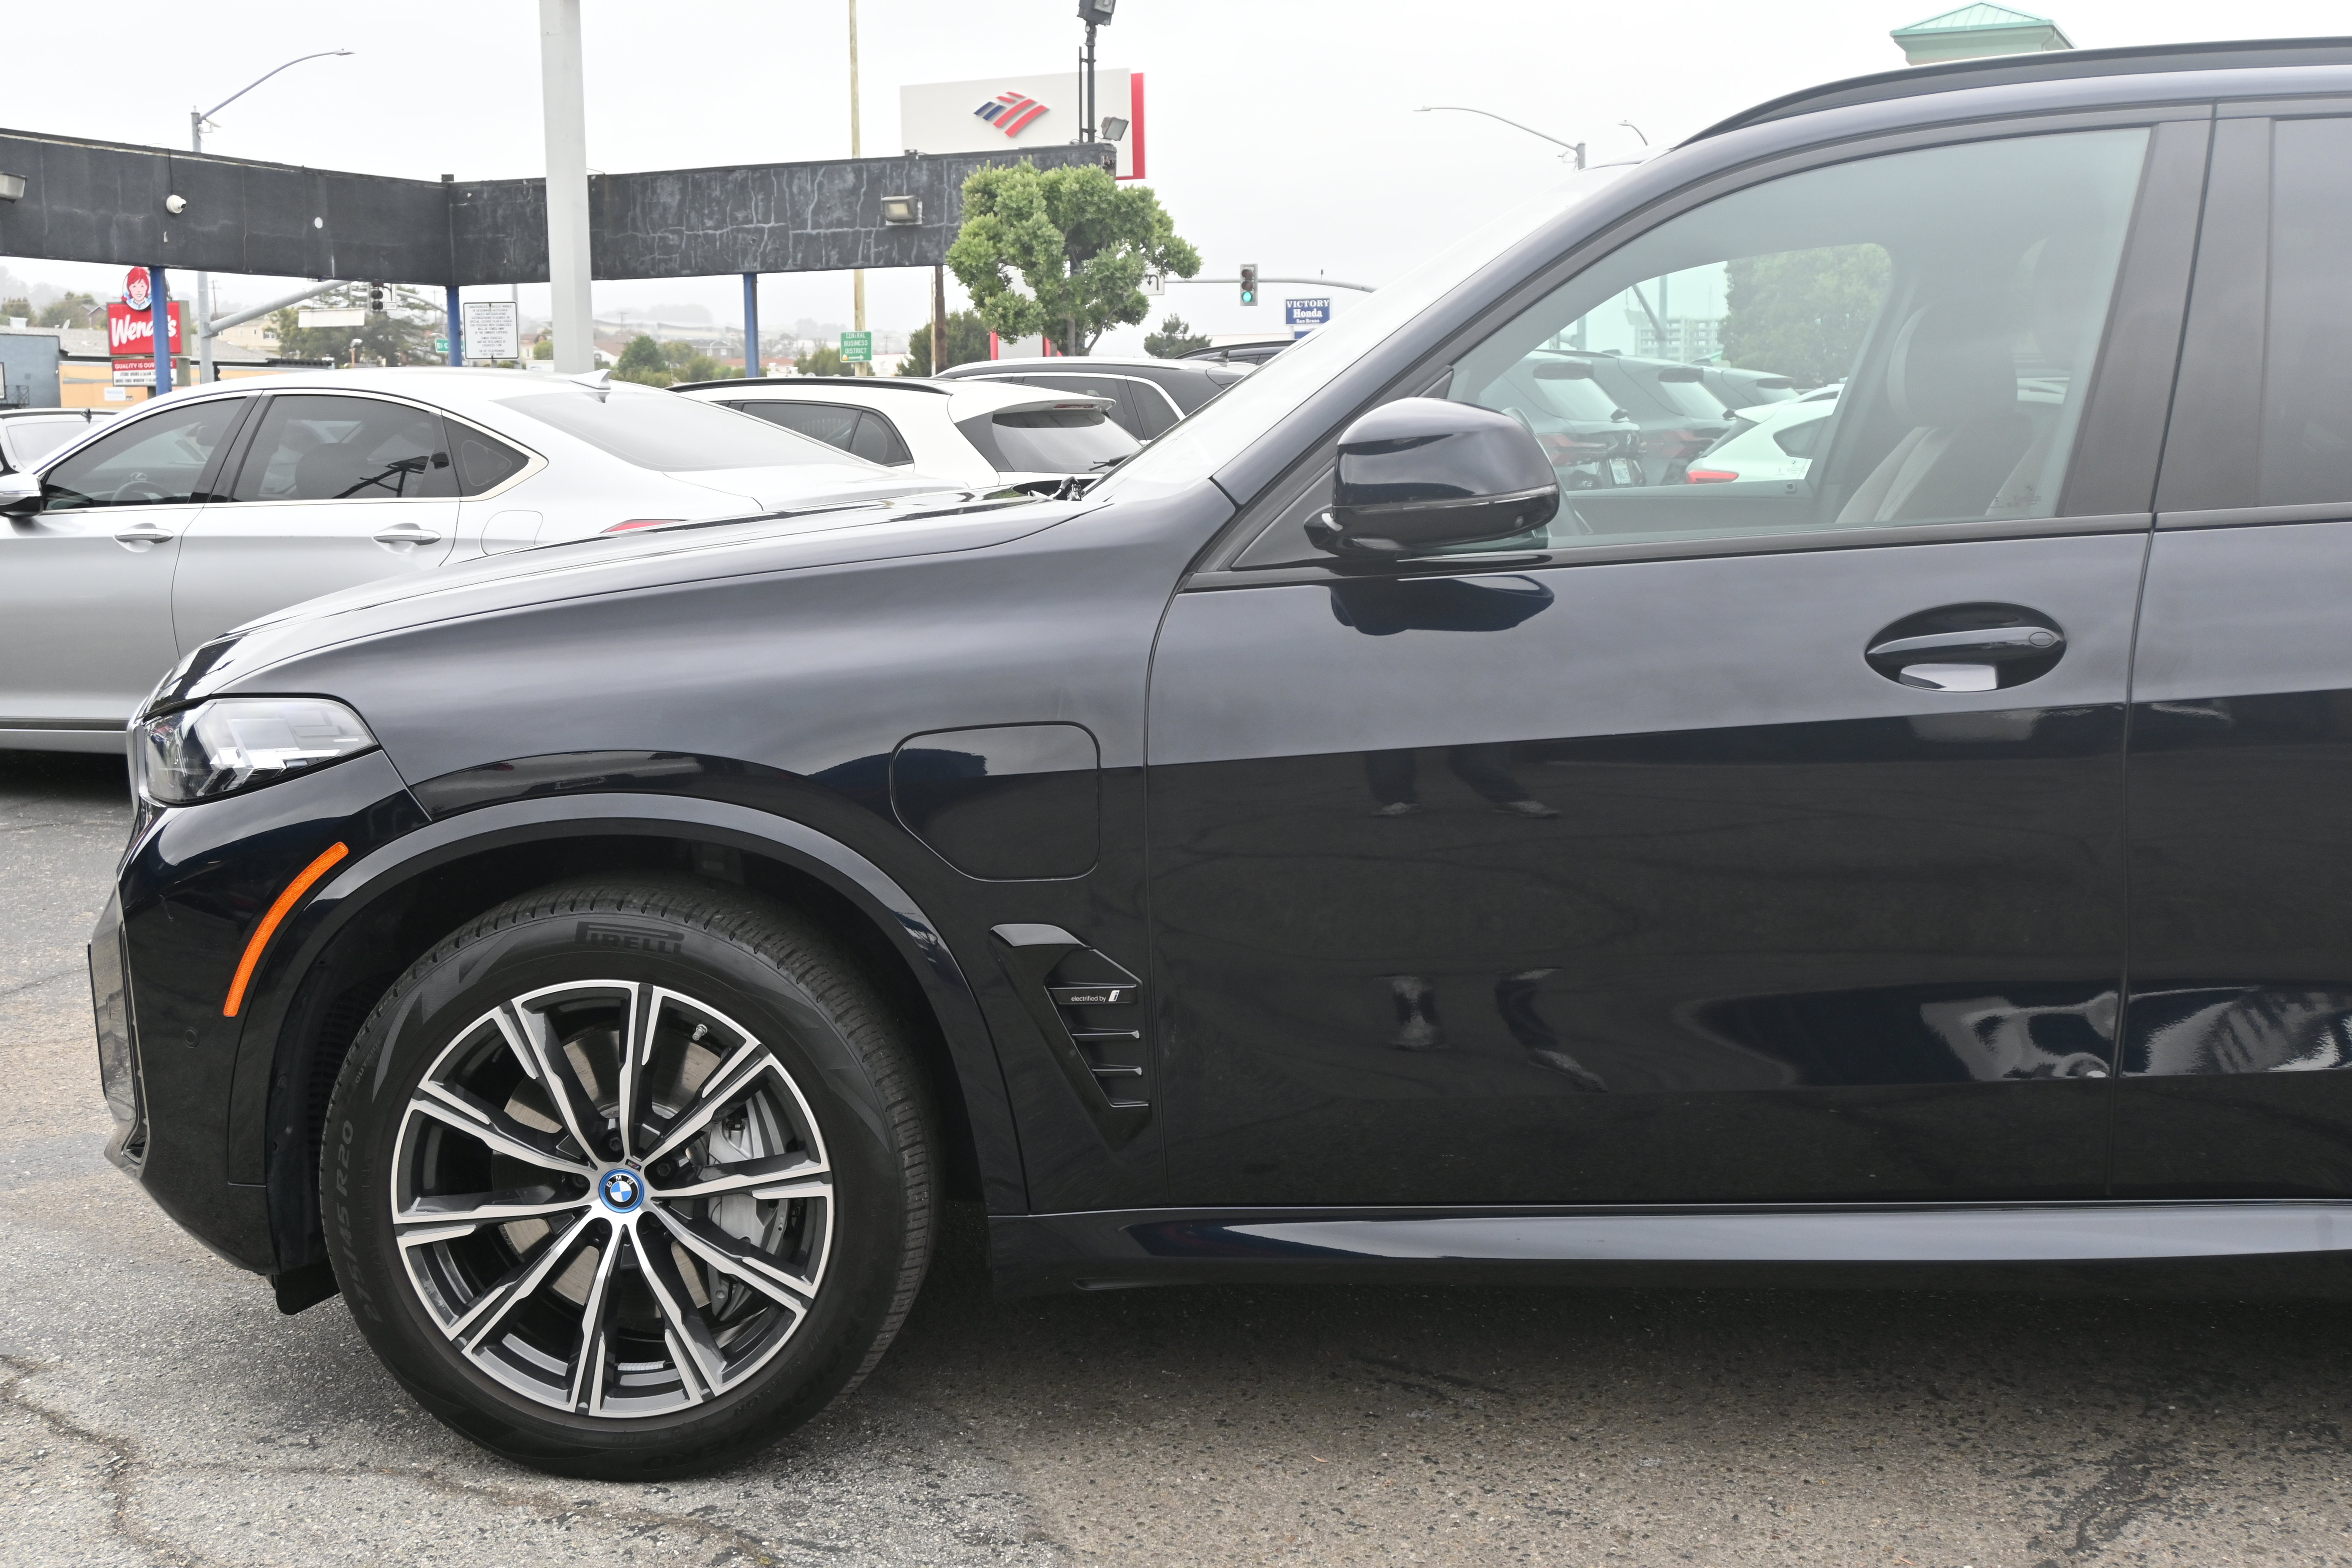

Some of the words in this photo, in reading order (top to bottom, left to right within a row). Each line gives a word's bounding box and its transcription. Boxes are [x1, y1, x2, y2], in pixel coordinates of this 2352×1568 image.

[1287, 299, 1329, 308] VICTORY
[1293, 308, 1323, 317] Honda
[111, 314, 177, 347] Wen's
[575, 921, 684, 956] PIRELLI
[355, 1037, 383, 1084] OUTSIDE
[336, 1120, 353, 1196] R20
[606, 1175, 634, 1188] BMW
[336, 1203, 383, 1323] 275/45
